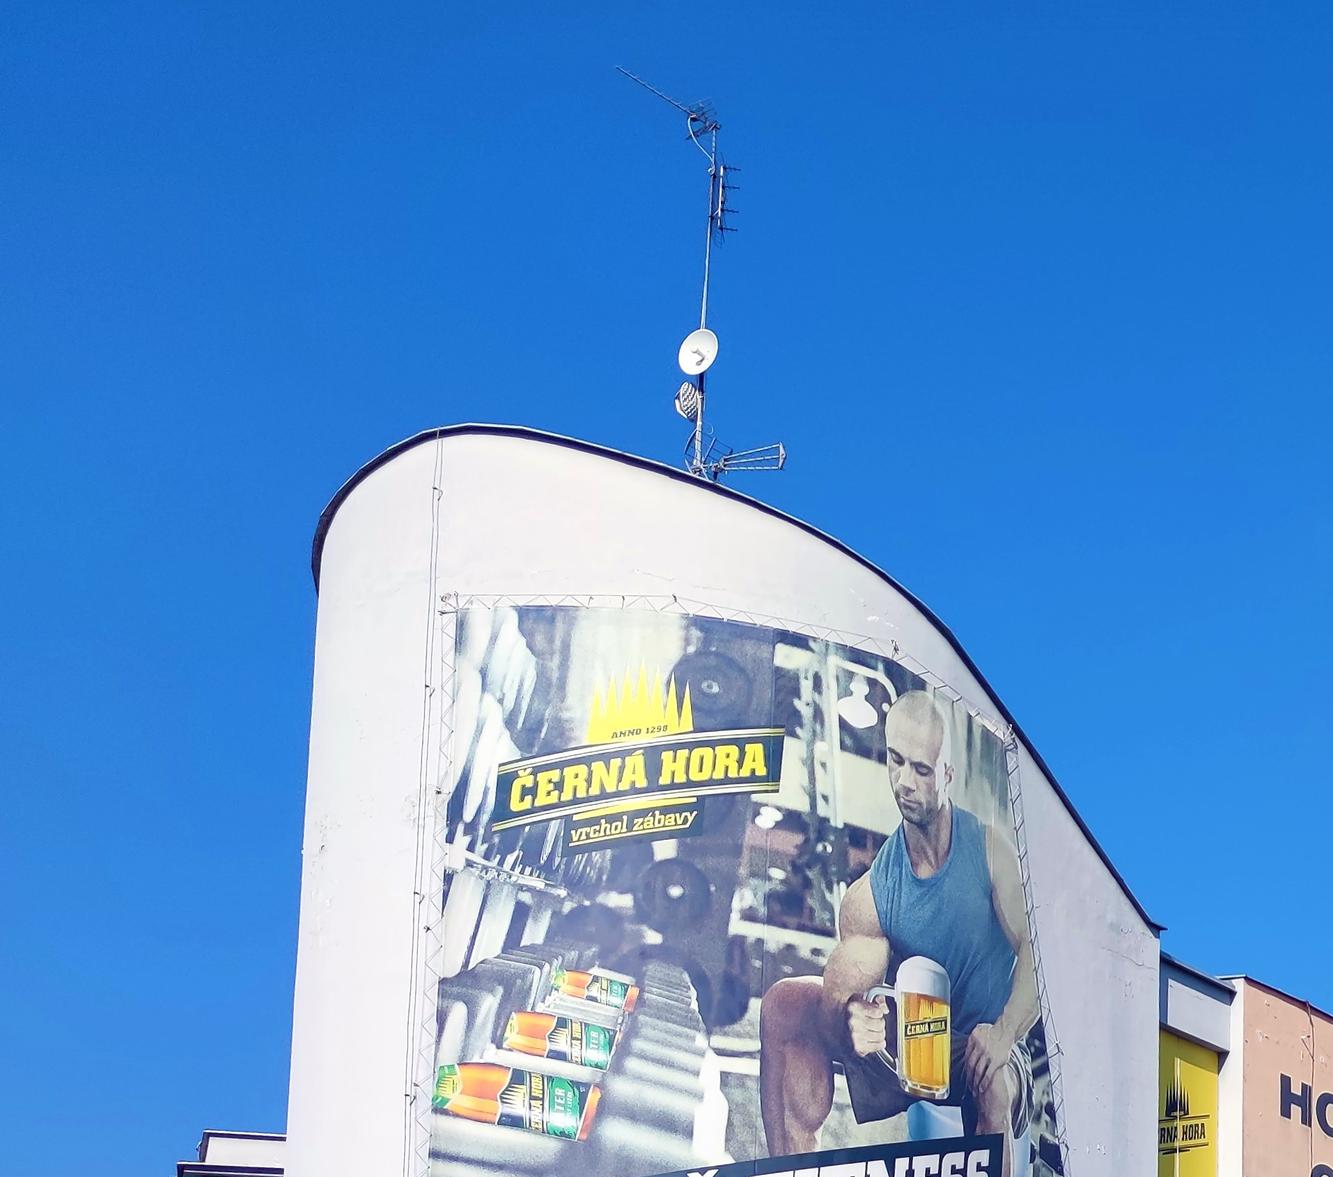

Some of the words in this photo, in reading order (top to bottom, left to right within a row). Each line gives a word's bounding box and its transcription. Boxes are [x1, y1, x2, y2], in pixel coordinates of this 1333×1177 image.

[509, 750, 648, 812] ČERNÁ
[658, 743, 767, 785] HORA
[570, 814, 628, 843] vrchol
[633, 809, 697, 830] zábavy
[1182, 1123, 1206, 1141] HORA
